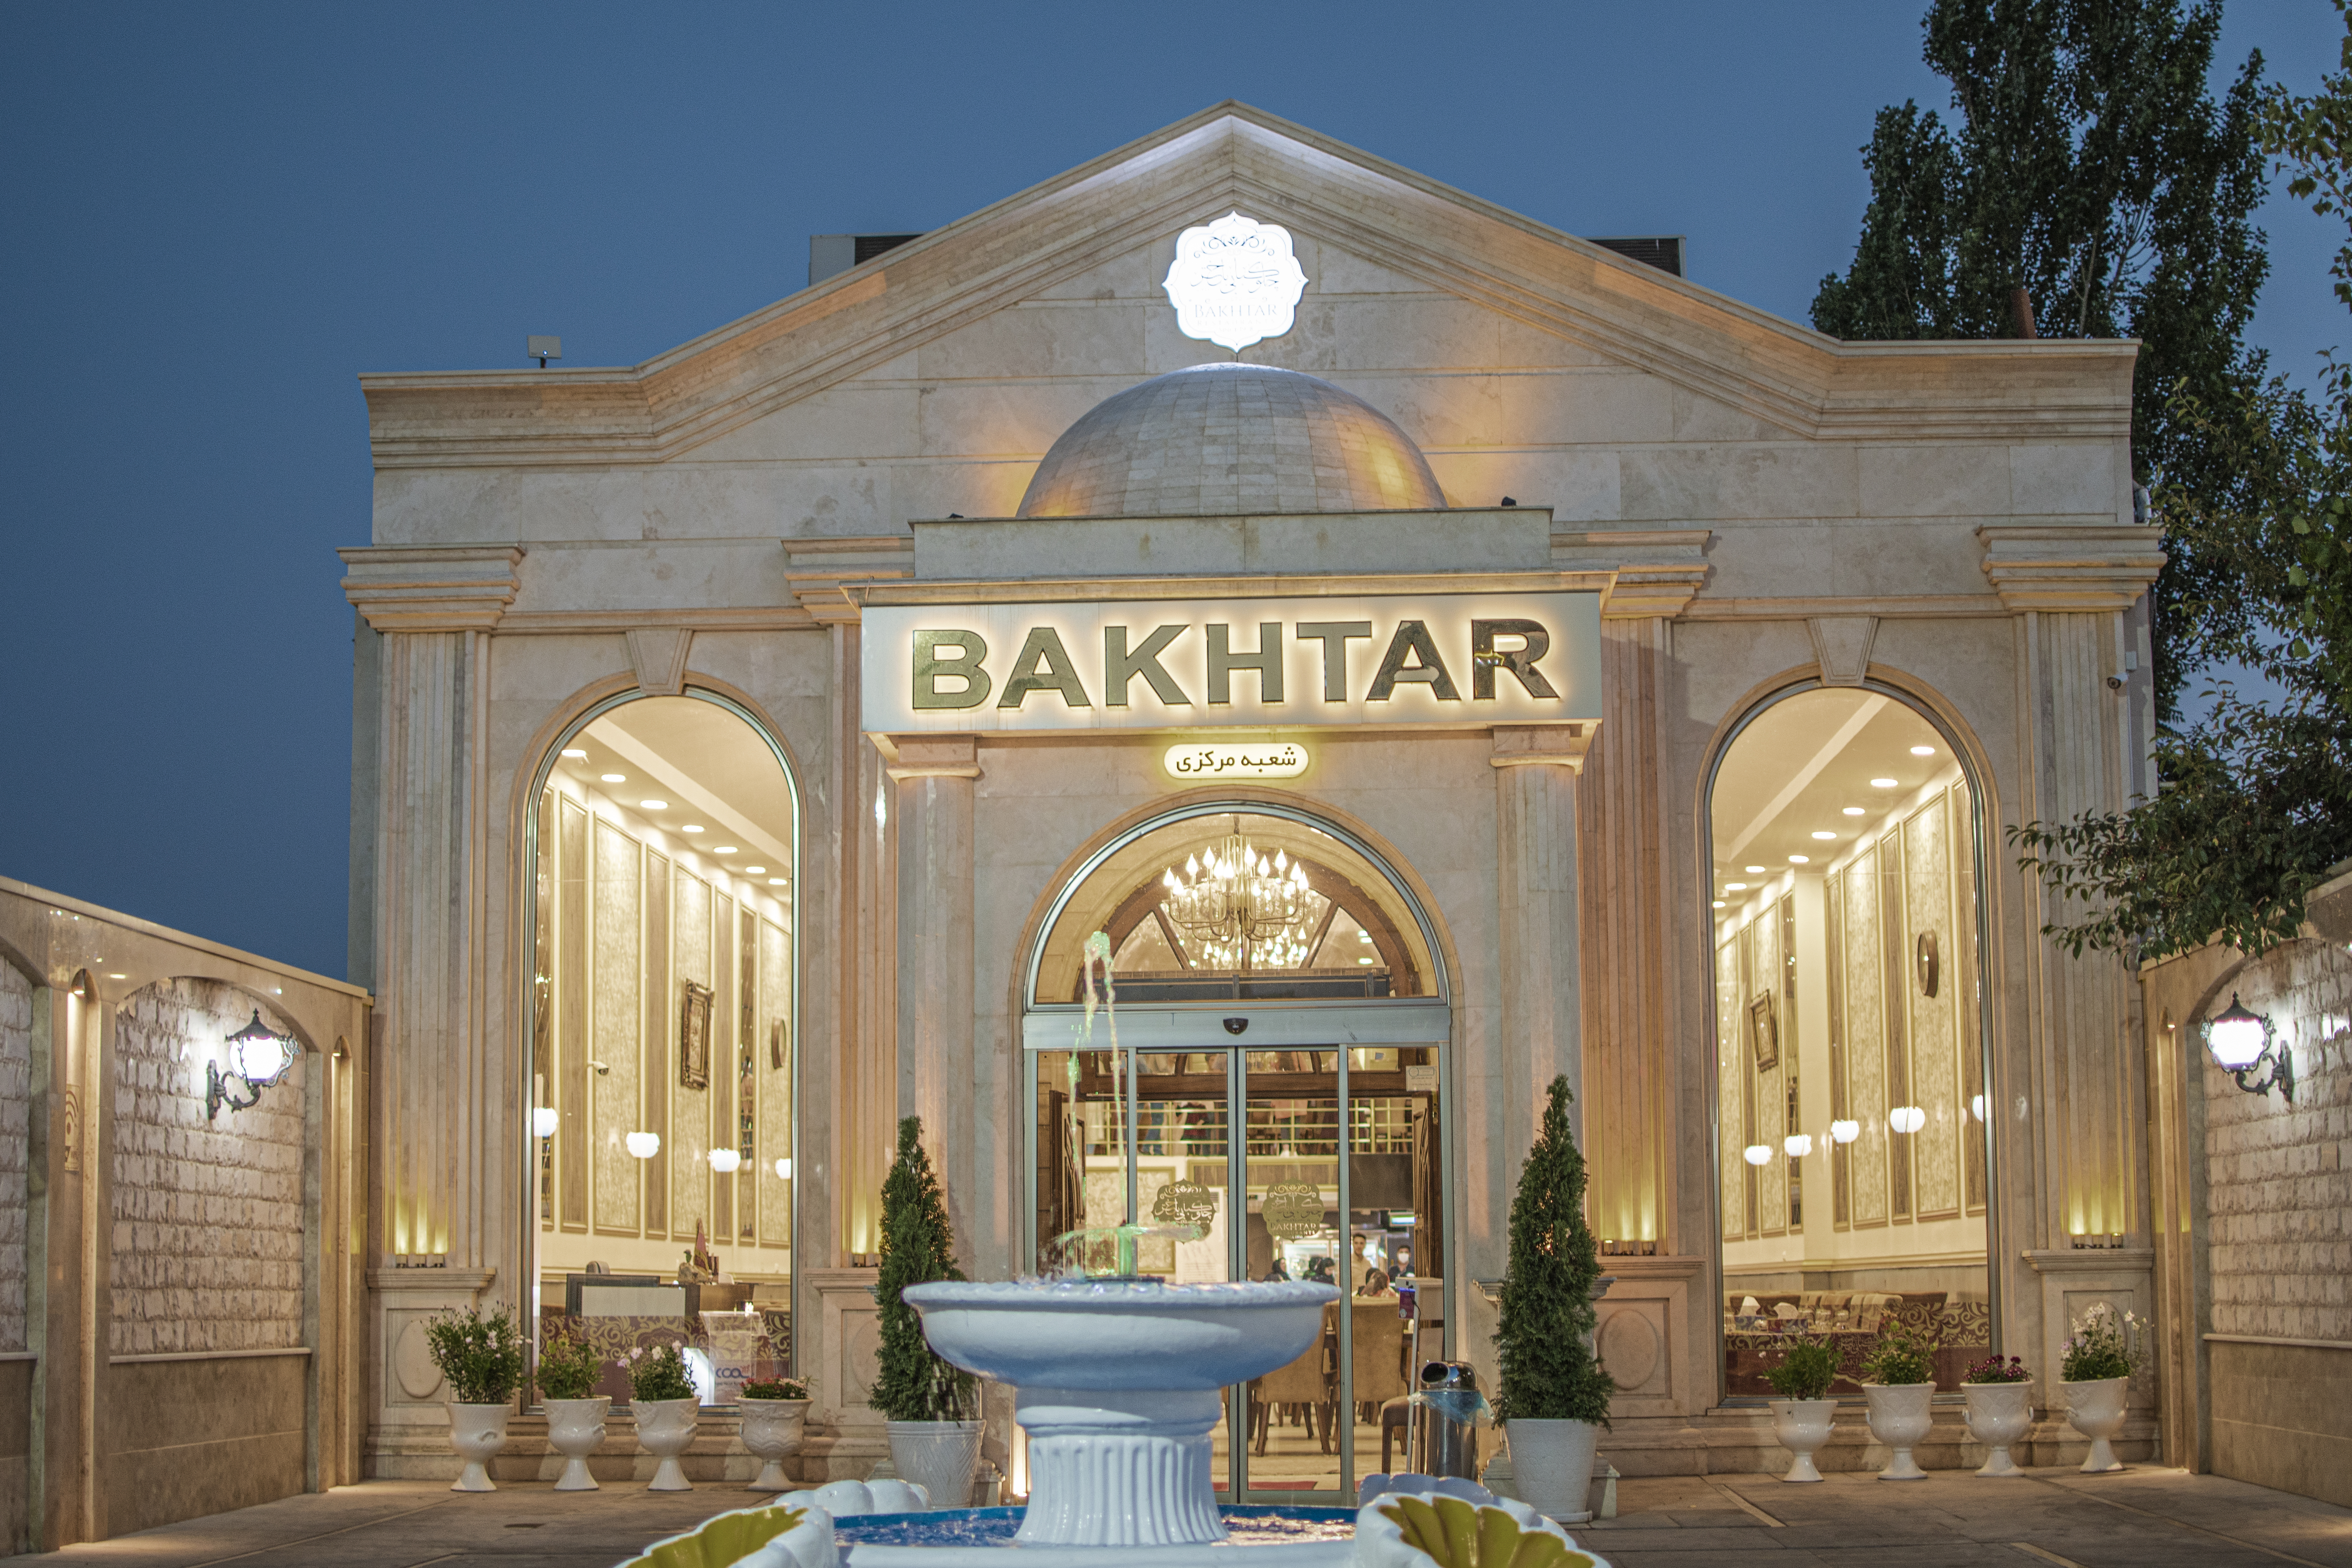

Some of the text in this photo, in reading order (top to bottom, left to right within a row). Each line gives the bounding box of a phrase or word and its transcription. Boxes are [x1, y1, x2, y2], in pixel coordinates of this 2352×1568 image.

[1195, 304, 1277, 318] BAKHTAR
[912, 619, 1560, 710] BAKHTAR
[1176, 746, 1297, 773] شعبه مرکزی
